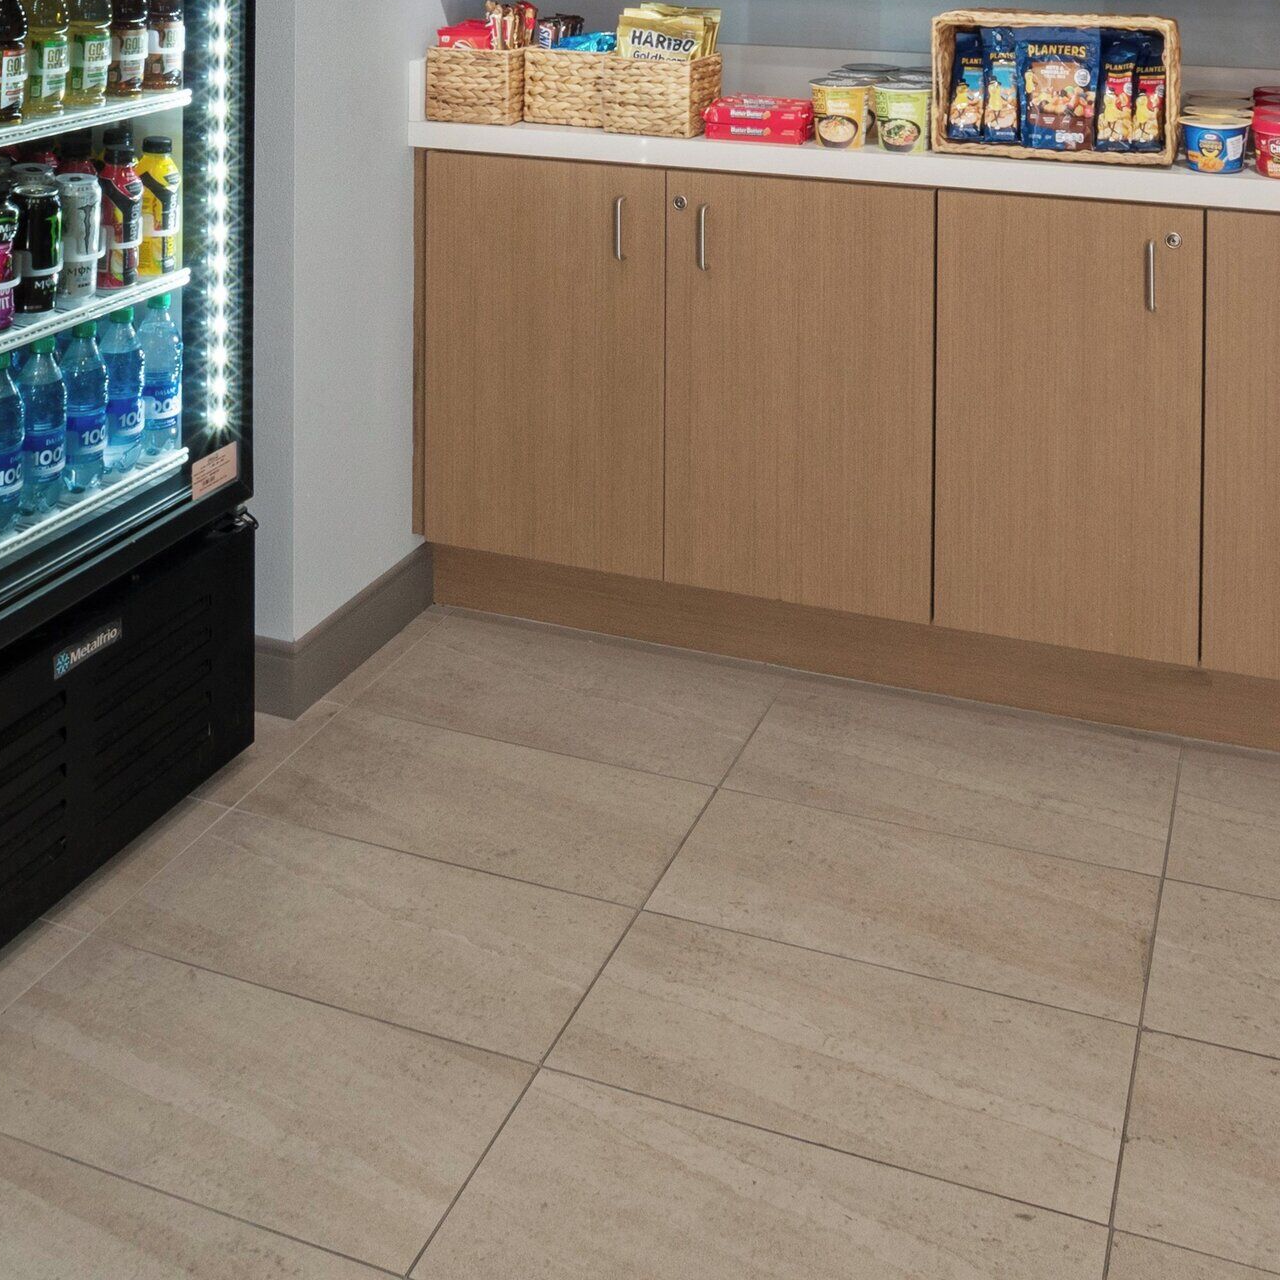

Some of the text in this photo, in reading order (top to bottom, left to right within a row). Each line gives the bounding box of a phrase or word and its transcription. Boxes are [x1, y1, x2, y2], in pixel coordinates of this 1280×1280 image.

[631, 29, 695, 52] HARIBO
[1027, 44, 1087, 58] PLANTERS
[961, 57, 982, 65] PLANT
[70, 627, 118, 664] Metalfrio
